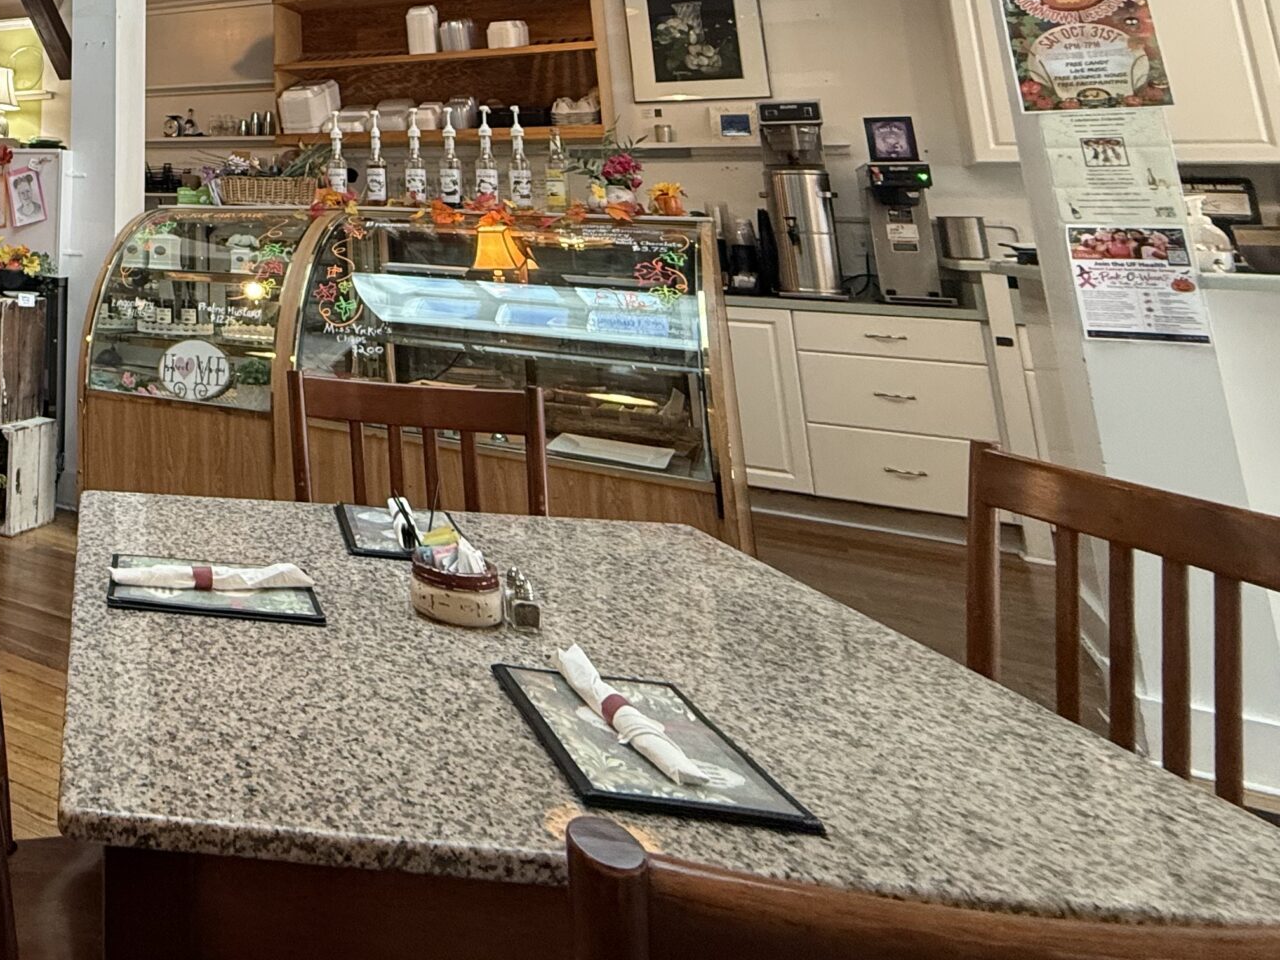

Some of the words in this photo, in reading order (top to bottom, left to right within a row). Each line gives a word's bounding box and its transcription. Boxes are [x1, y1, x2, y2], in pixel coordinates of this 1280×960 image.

[1039, 32, 1060, 50] SAT
[1060, 26, 1086, 40] OCT
[1091, 26, 1122, 43] 31ST
[1139, 261, 1167, 269] Health
[323, 323, 351, 334] Miss
